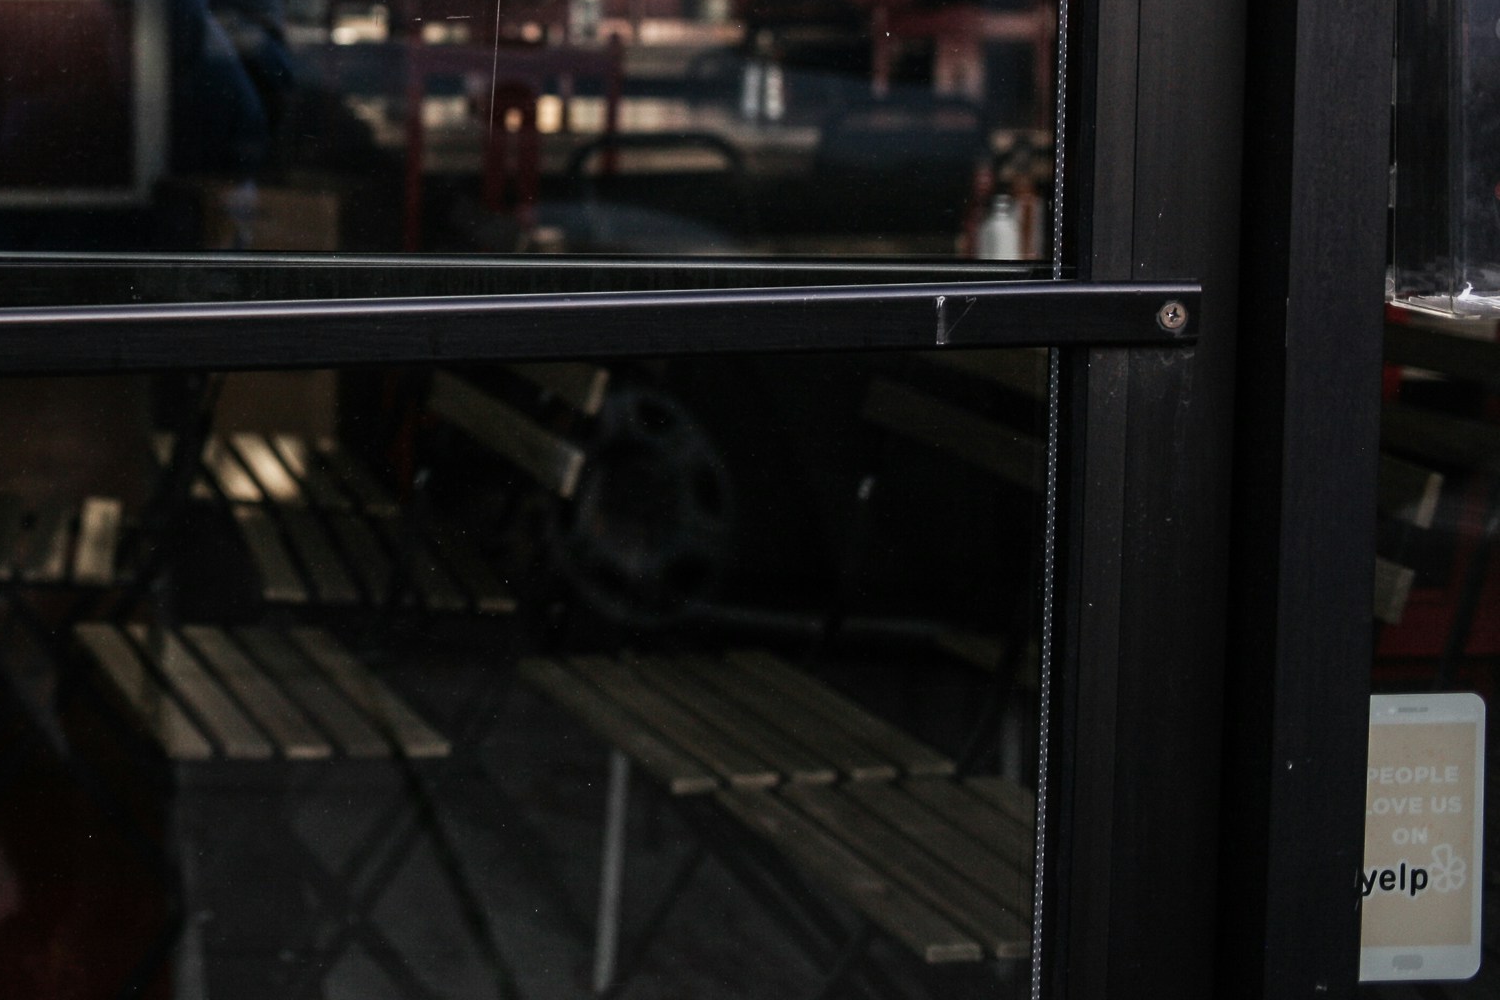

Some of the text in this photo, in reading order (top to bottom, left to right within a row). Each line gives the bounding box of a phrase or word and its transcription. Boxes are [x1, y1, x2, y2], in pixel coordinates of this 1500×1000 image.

[1366, 795, 1462, 815] OVE US
[1391, 827, 1428, 845] ON
